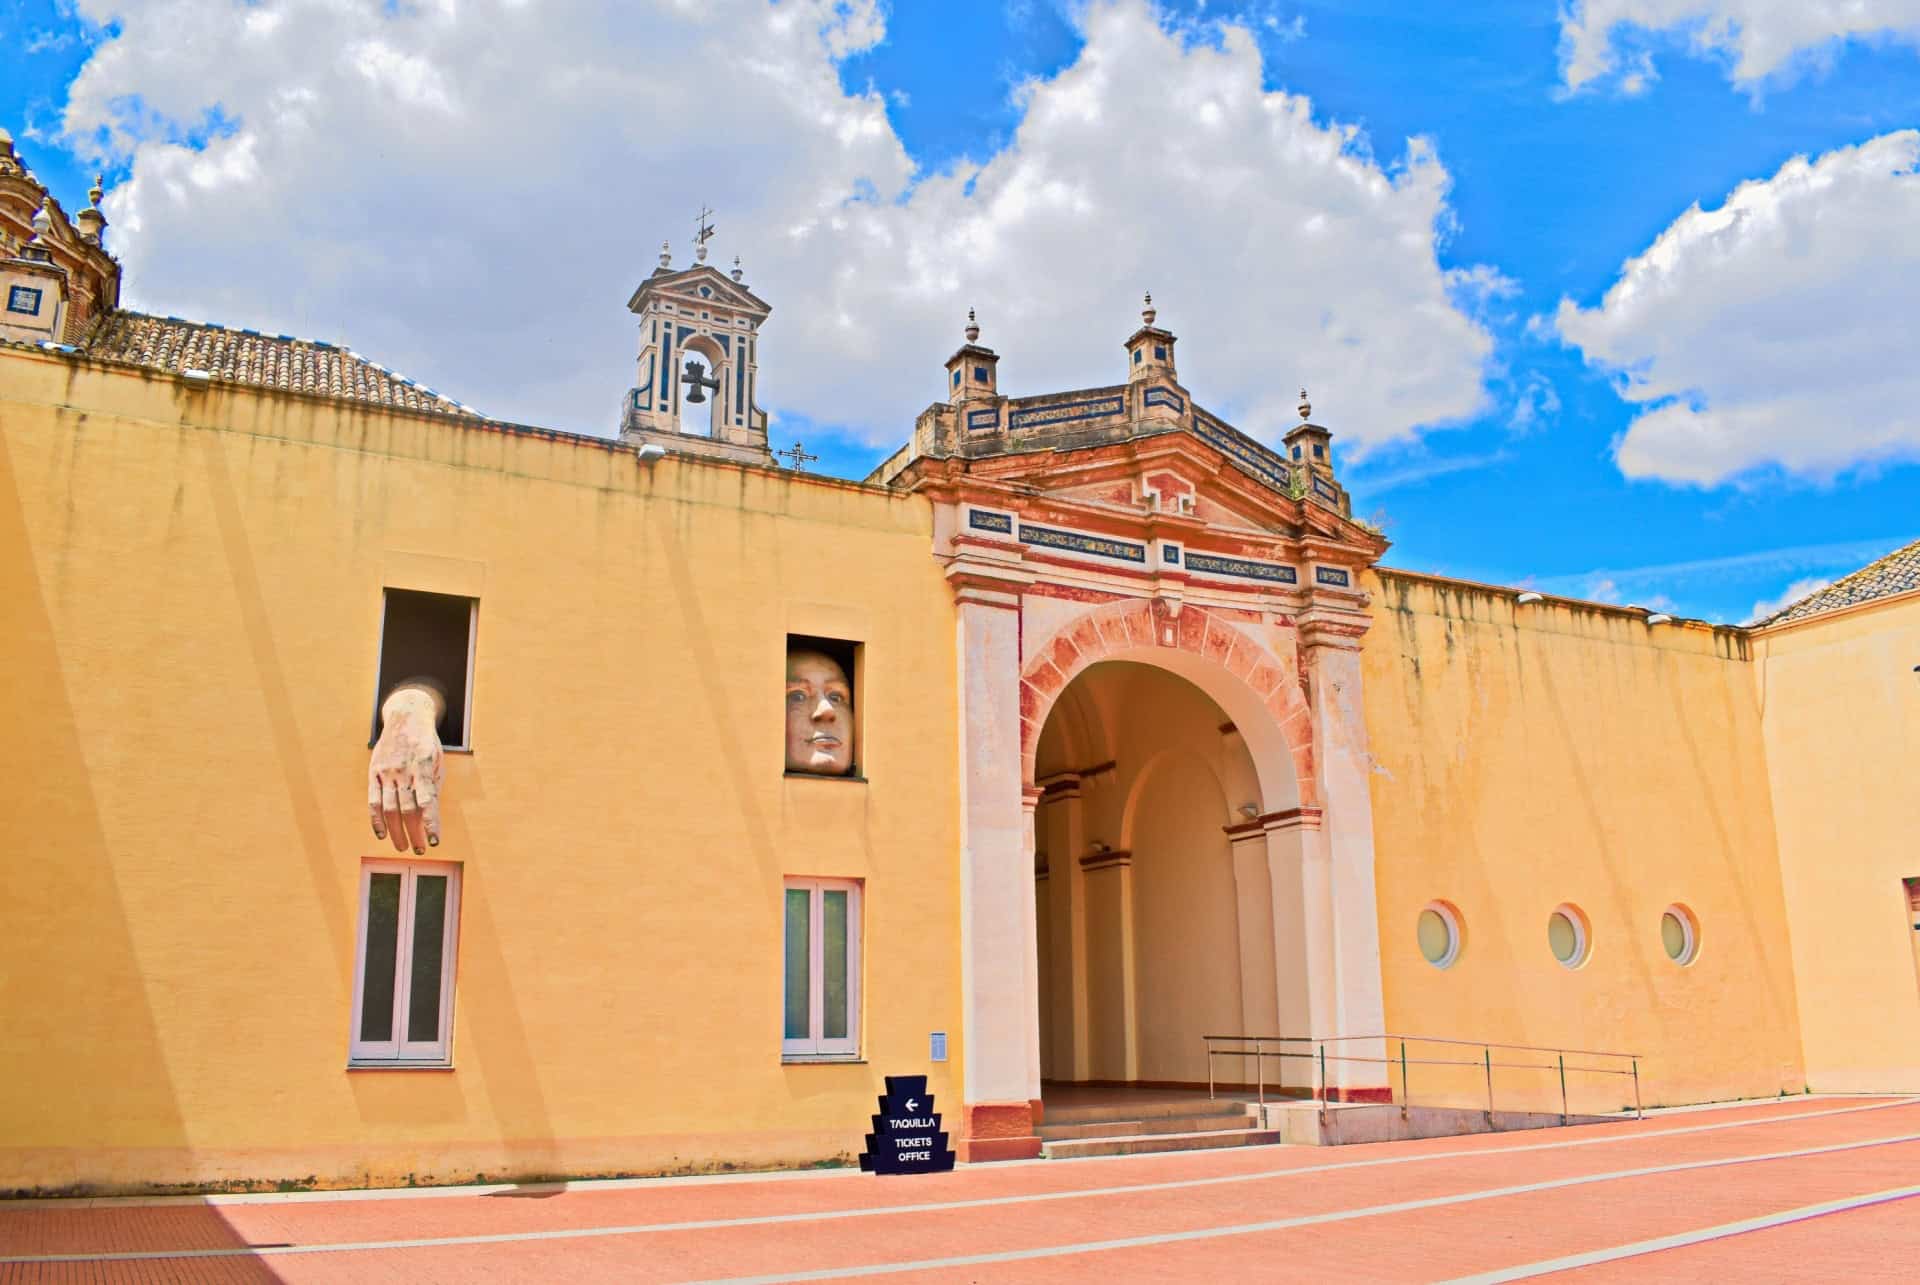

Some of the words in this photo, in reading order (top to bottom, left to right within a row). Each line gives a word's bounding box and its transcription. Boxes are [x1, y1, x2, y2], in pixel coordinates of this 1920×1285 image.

[890, 1118, 935, 1128] TAQUILLA
[894, 1137, 932, 1148] TICKETS
[898, 1151, 930, 1161] OFFICE
